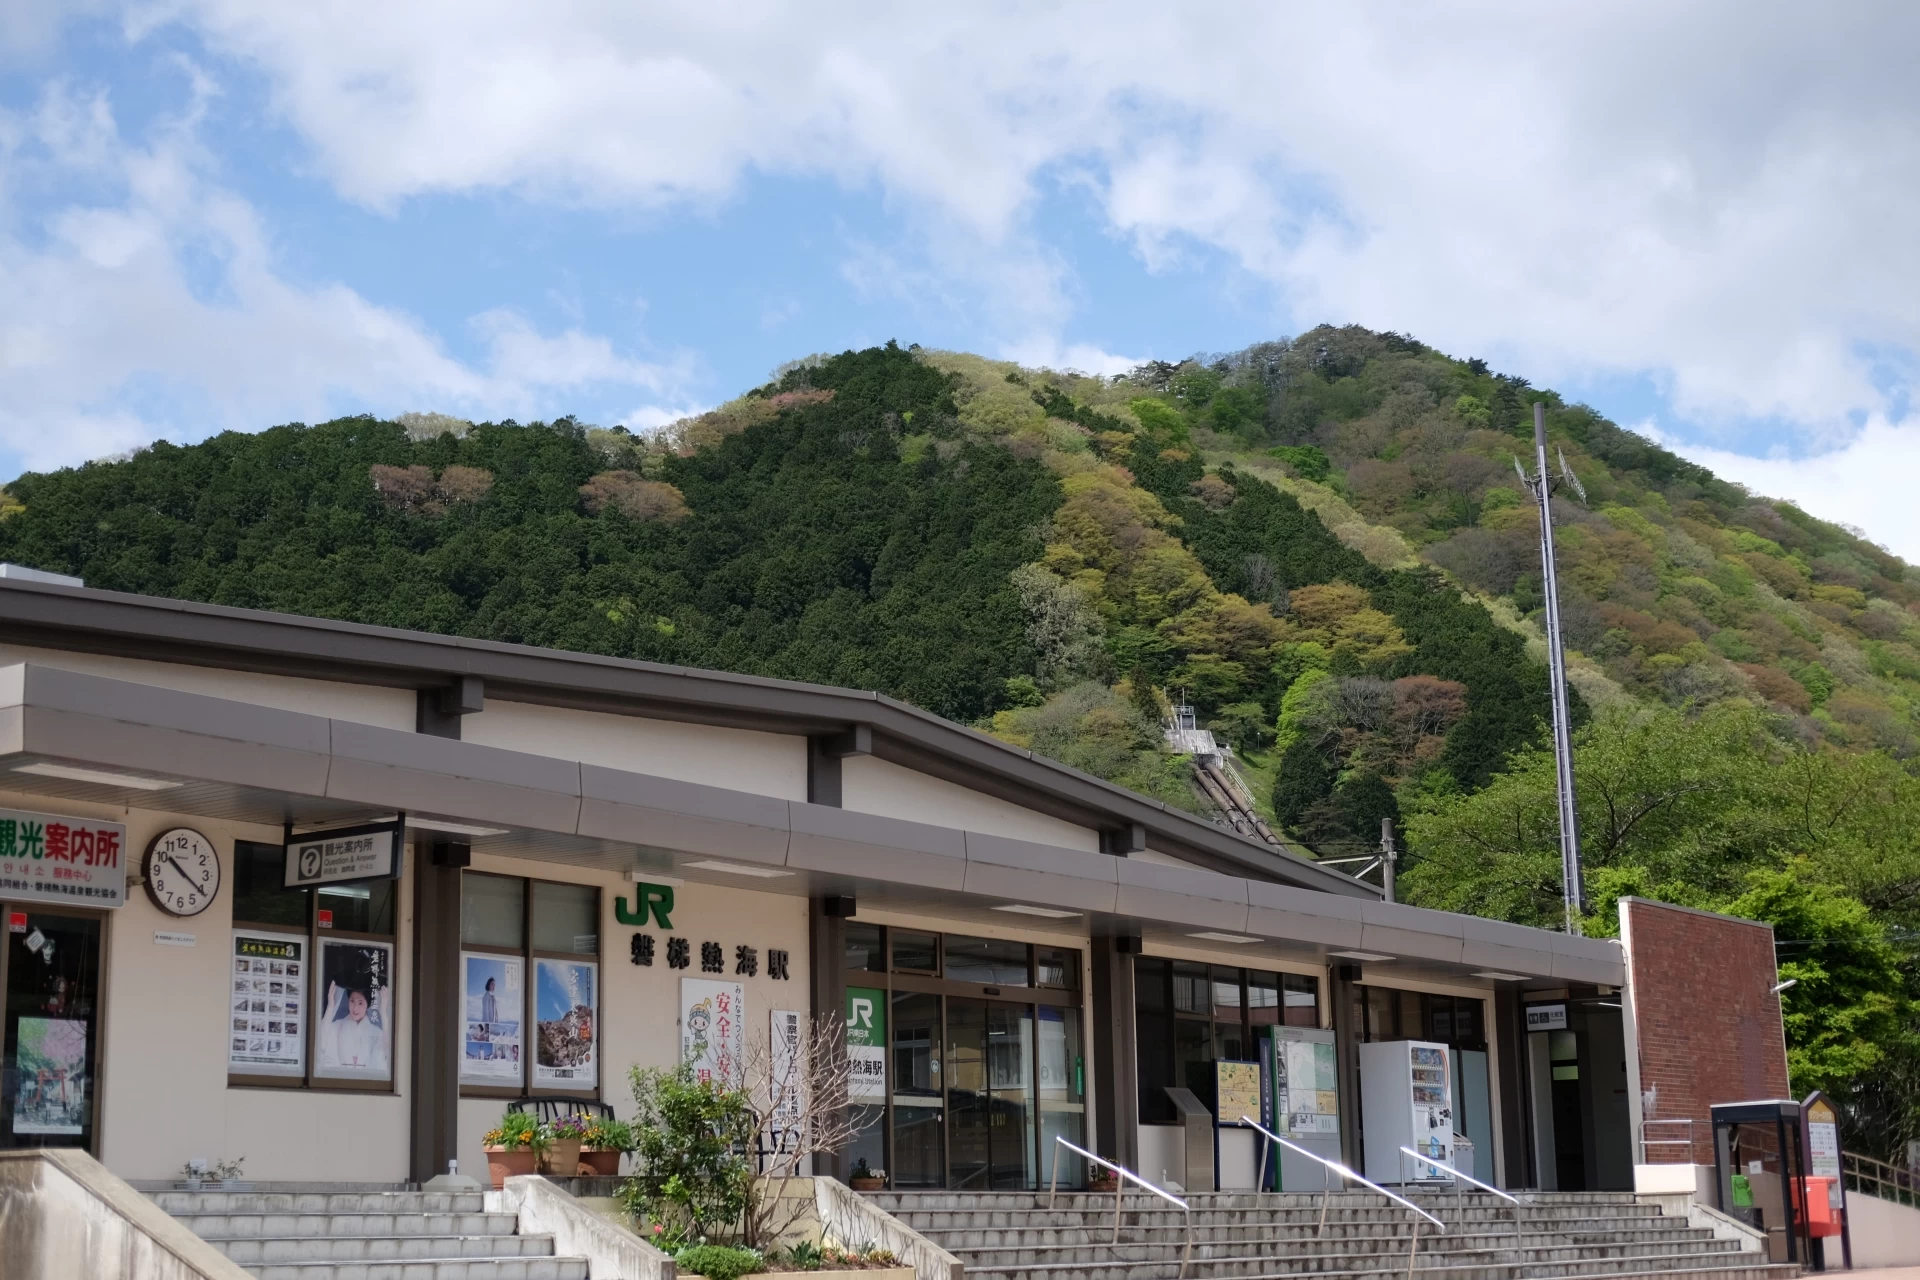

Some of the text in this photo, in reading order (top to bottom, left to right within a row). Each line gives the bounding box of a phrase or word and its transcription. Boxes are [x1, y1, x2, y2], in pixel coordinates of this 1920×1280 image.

[165, 840, 175, 852] 11
[176, 837, 188, 849] 12
[325, 838, 373, 856] 観光案内所
[192, 844, 197, 855] 1
[157, 851, 168, 863] 10
[199, 855, 206, 866] 2
[324, 858, 349, 866] Question
[356, 854, 377, 862] Answer
[153, 865, 160, 876] 9
[202, 870, 209, 881] 3
[157, 880, 164, 891] 8
[166, 892, 173, 903] 7
[177, 897, 184, 908] 6
[189, 894, 196, 905] 5
[615, 881, 675, 930] JR
[631, 932, 790, 981] 磐梯熱海駅
[847, 998, 873, 1028] JR
[847, 1028, 869, 1038] JR東日本
